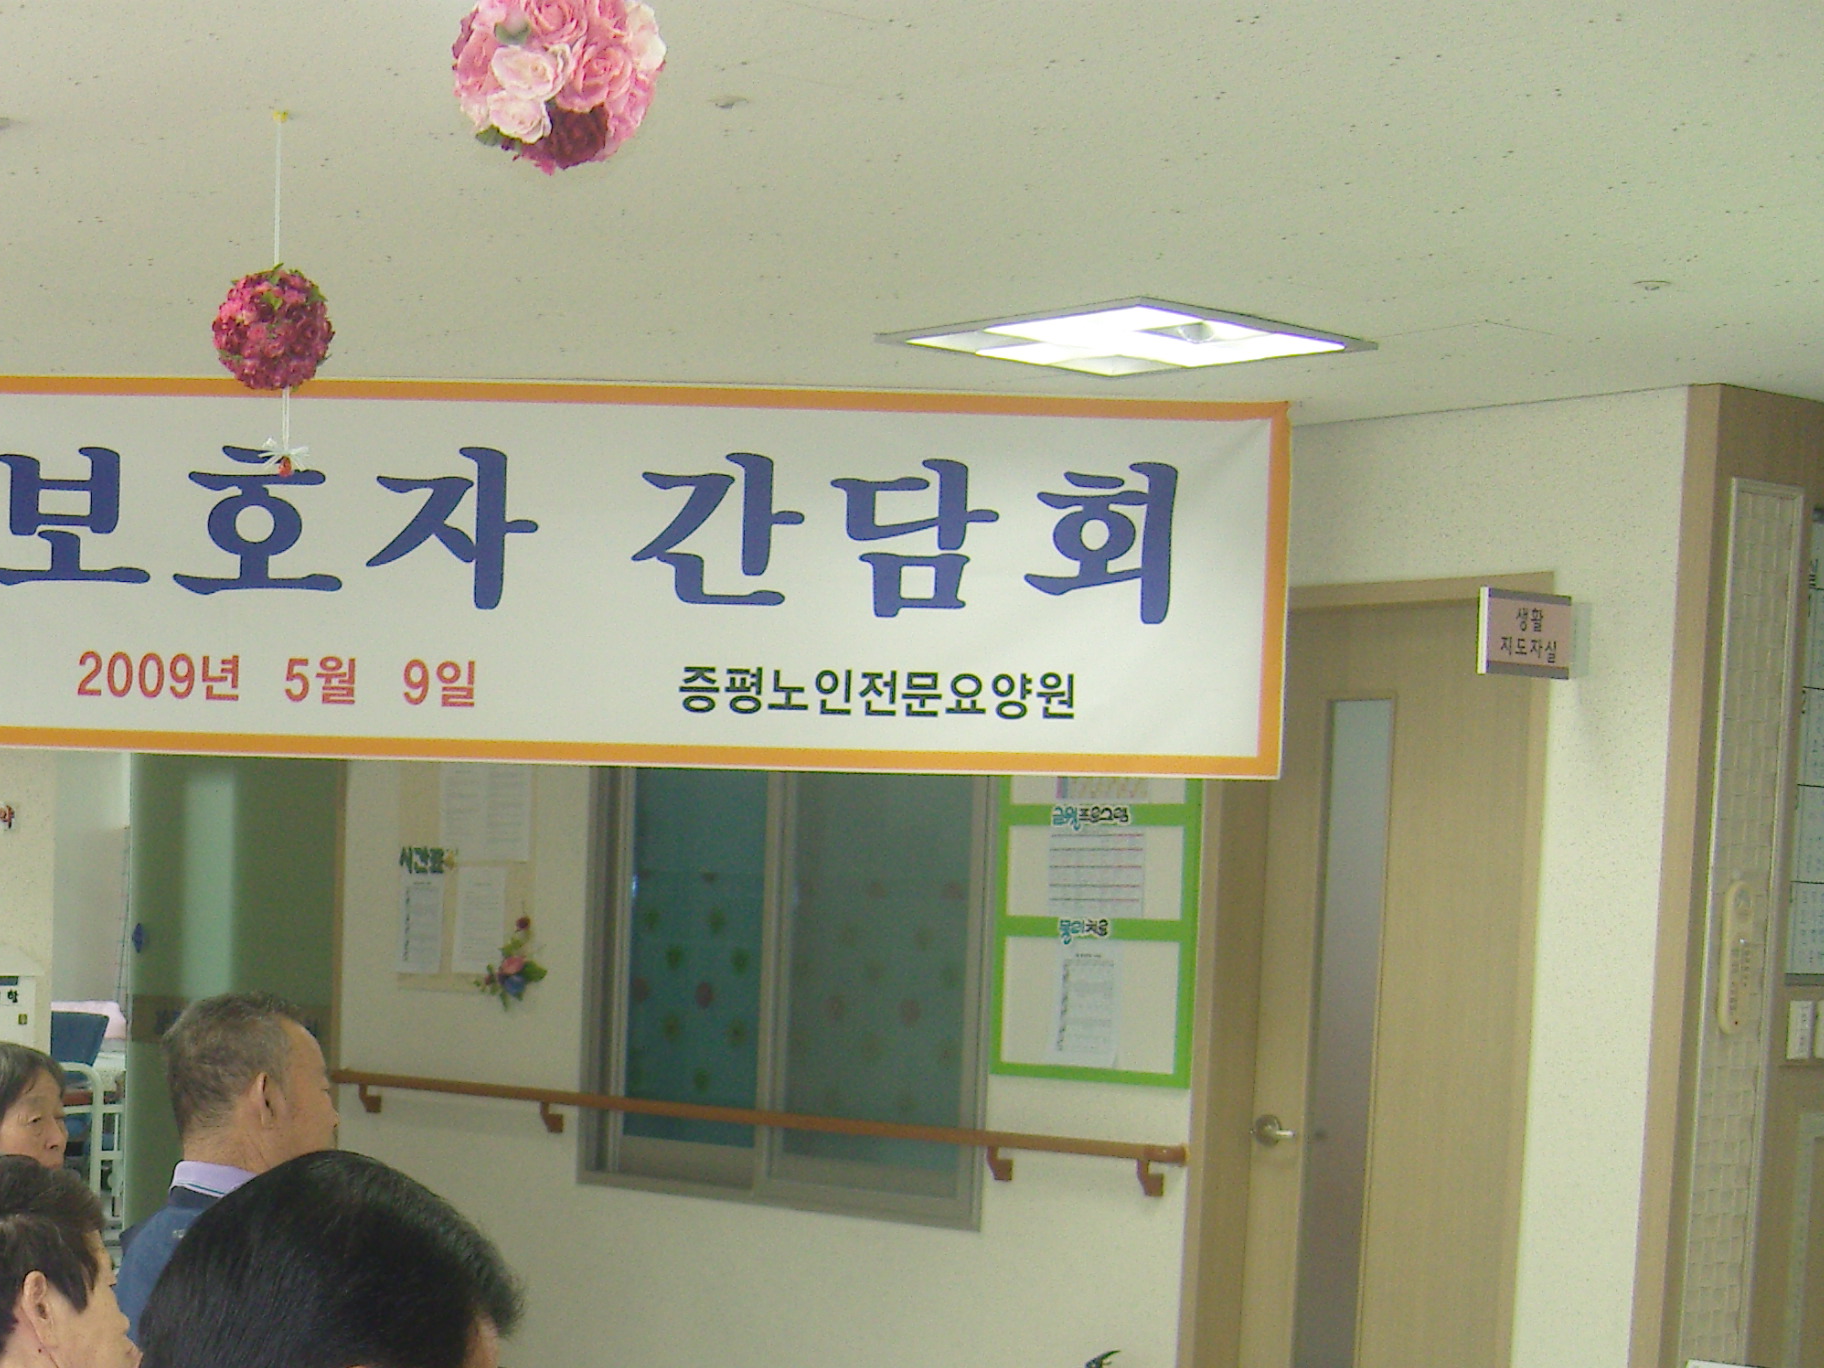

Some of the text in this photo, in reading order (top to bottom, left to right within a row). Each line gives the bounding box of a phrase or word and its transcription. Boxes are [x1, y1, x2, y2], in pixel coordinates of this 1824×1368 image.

[631, 452, 1179, 625] 간담회
[1515, 606, 1544, 633] 생활
[1500, 636, 1557, 664] 지도자실
[77, 650, 476, 708] 2009년 5월 9일
[678, 665, 1076, 720] 증평노인전문요양원
